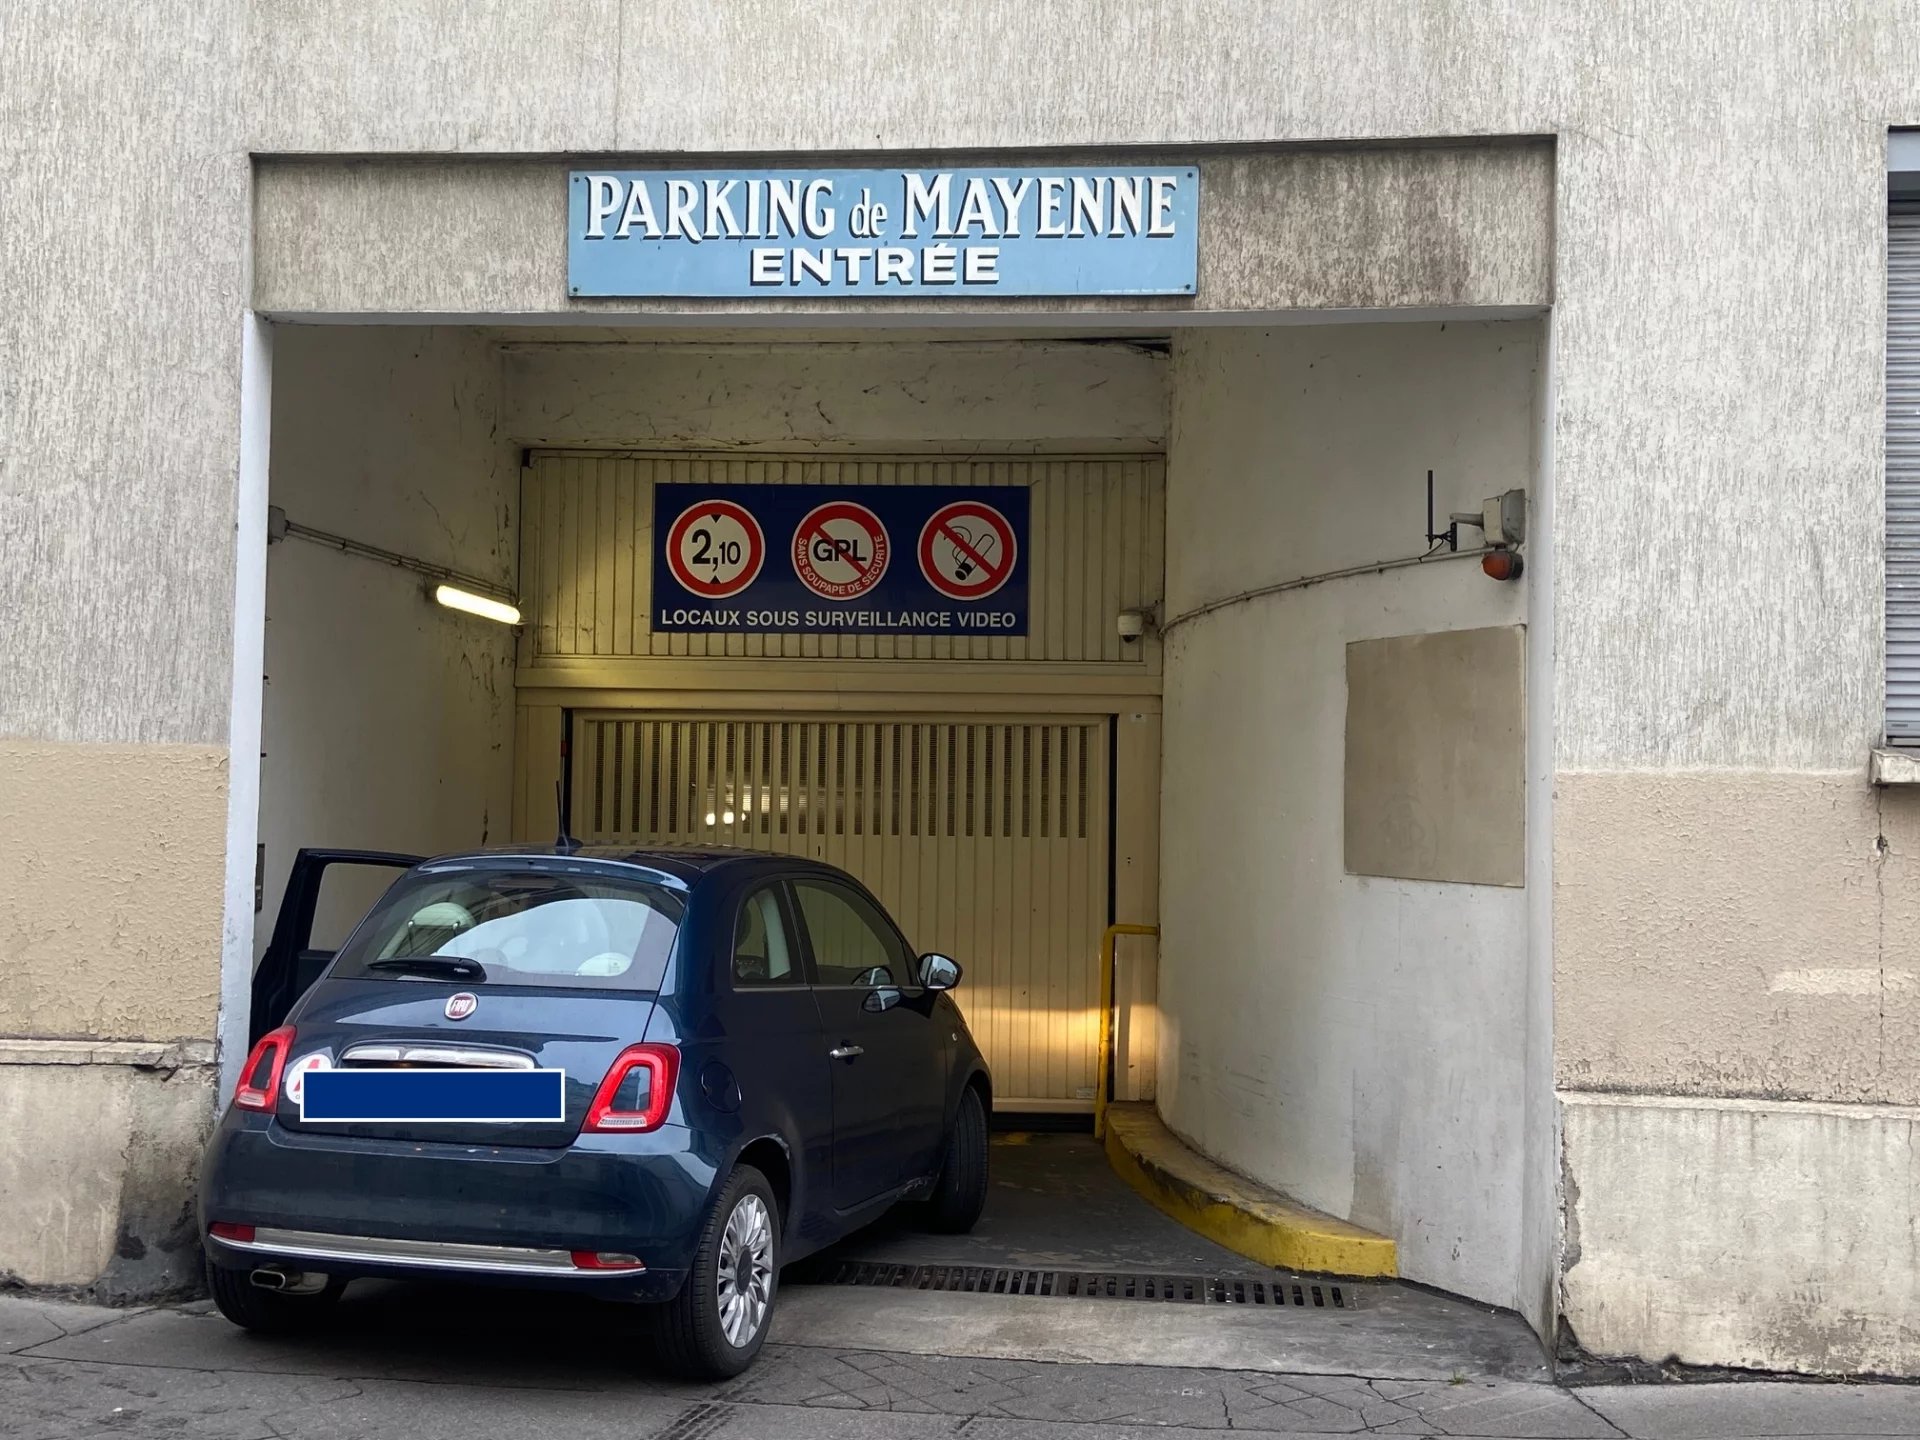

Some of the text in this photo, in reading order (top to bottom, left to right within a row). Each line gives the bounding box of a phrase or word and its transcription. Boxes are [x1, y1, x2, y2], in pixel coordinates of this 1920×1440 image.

[584, 173, 1177, 245] PARKING de MAYENNE
[750, 242, 1000, 287] ENTRÉE
[691, 528, 741, 573] 2,10
[797, 537, 808, 567] SANS
[813, 538, 868, 562] GPL
[802, 566, 846, 595] SOUPAPE
[847, 583, 863, 594] DE
[661, 609, 1017, 629] LOCAUX SOUS SURVEILLANCE VIDEO
